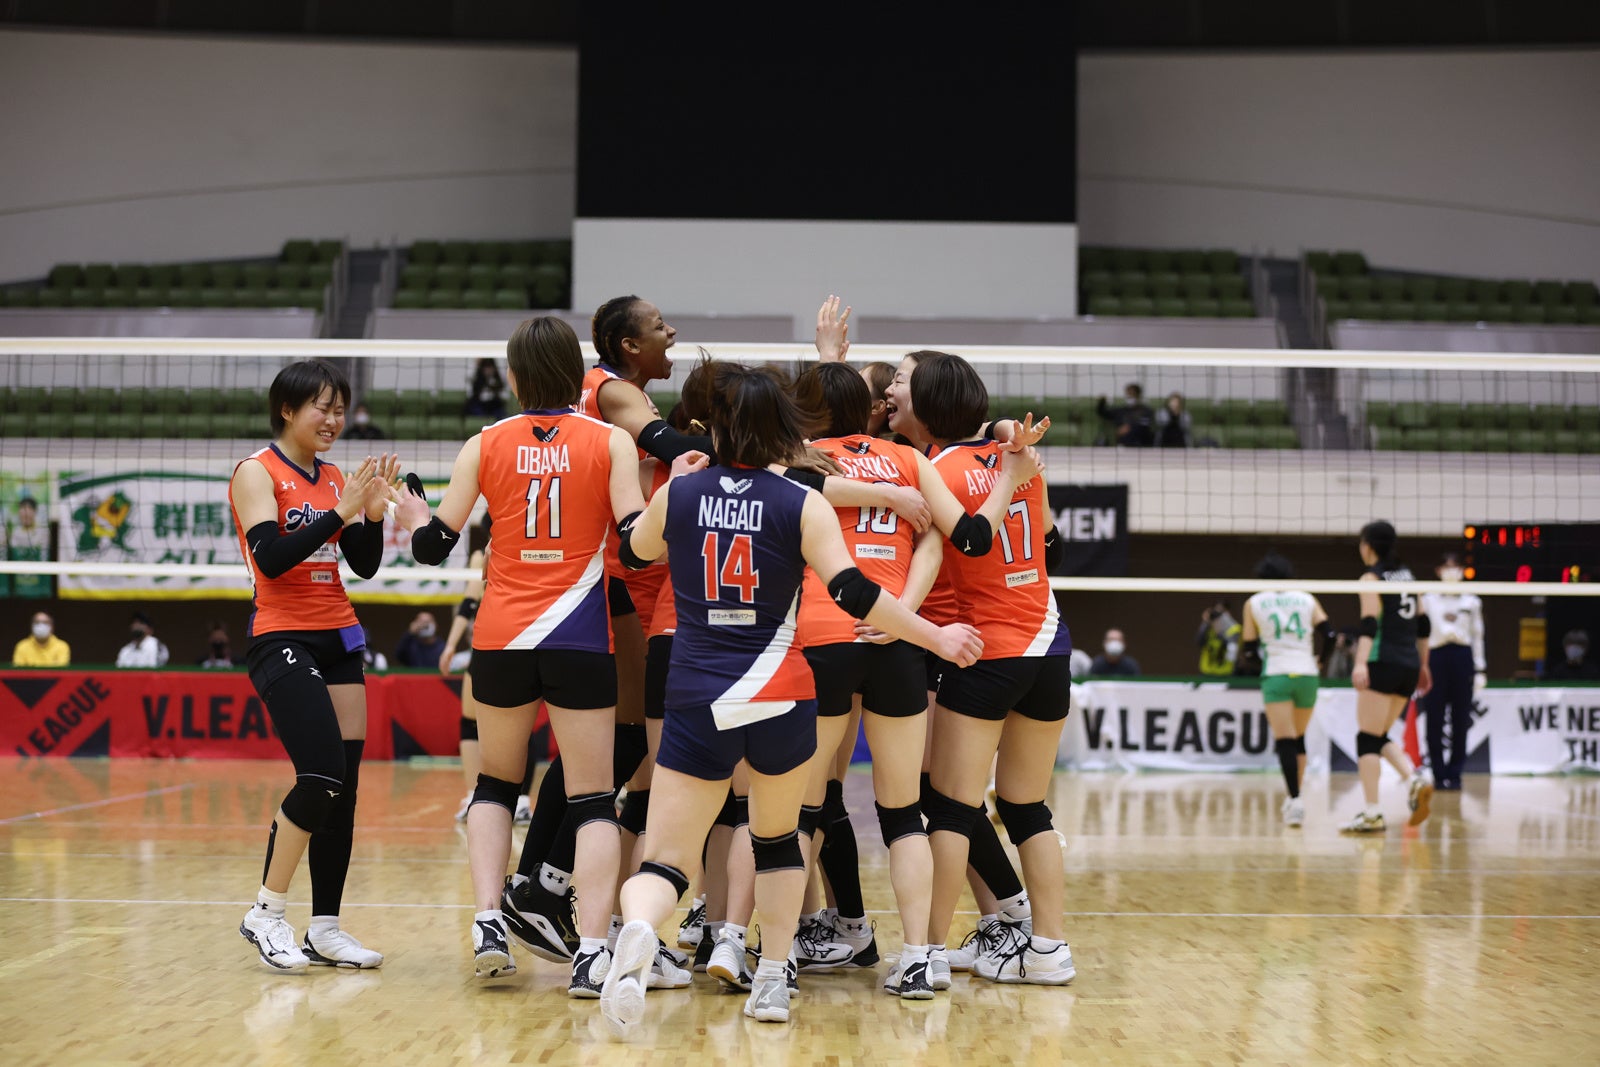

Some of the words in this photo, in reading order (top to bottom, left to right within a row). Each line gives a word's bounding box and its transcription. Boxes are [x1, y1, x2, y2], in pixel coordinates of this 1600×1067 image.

[516, 444, 571, 475] OBANA
[153, 502, 238, 538] 群馬
[525, 476, 561, 538] 11
[698, 495, 763, 531] NAGAO
[997, 498, 1032, 565] 17
[701, 531, 760, 604] 14
[1398, 592, 1416, 620] 5
[1268, 611, 1307, 641] 14
[282, 648, 297, 664] 2
[142, 694, 280, 739] V.LEA
[1083, 708, 1272, 755] V.LEAGU
[1519, 705, 1560, 731] WE
